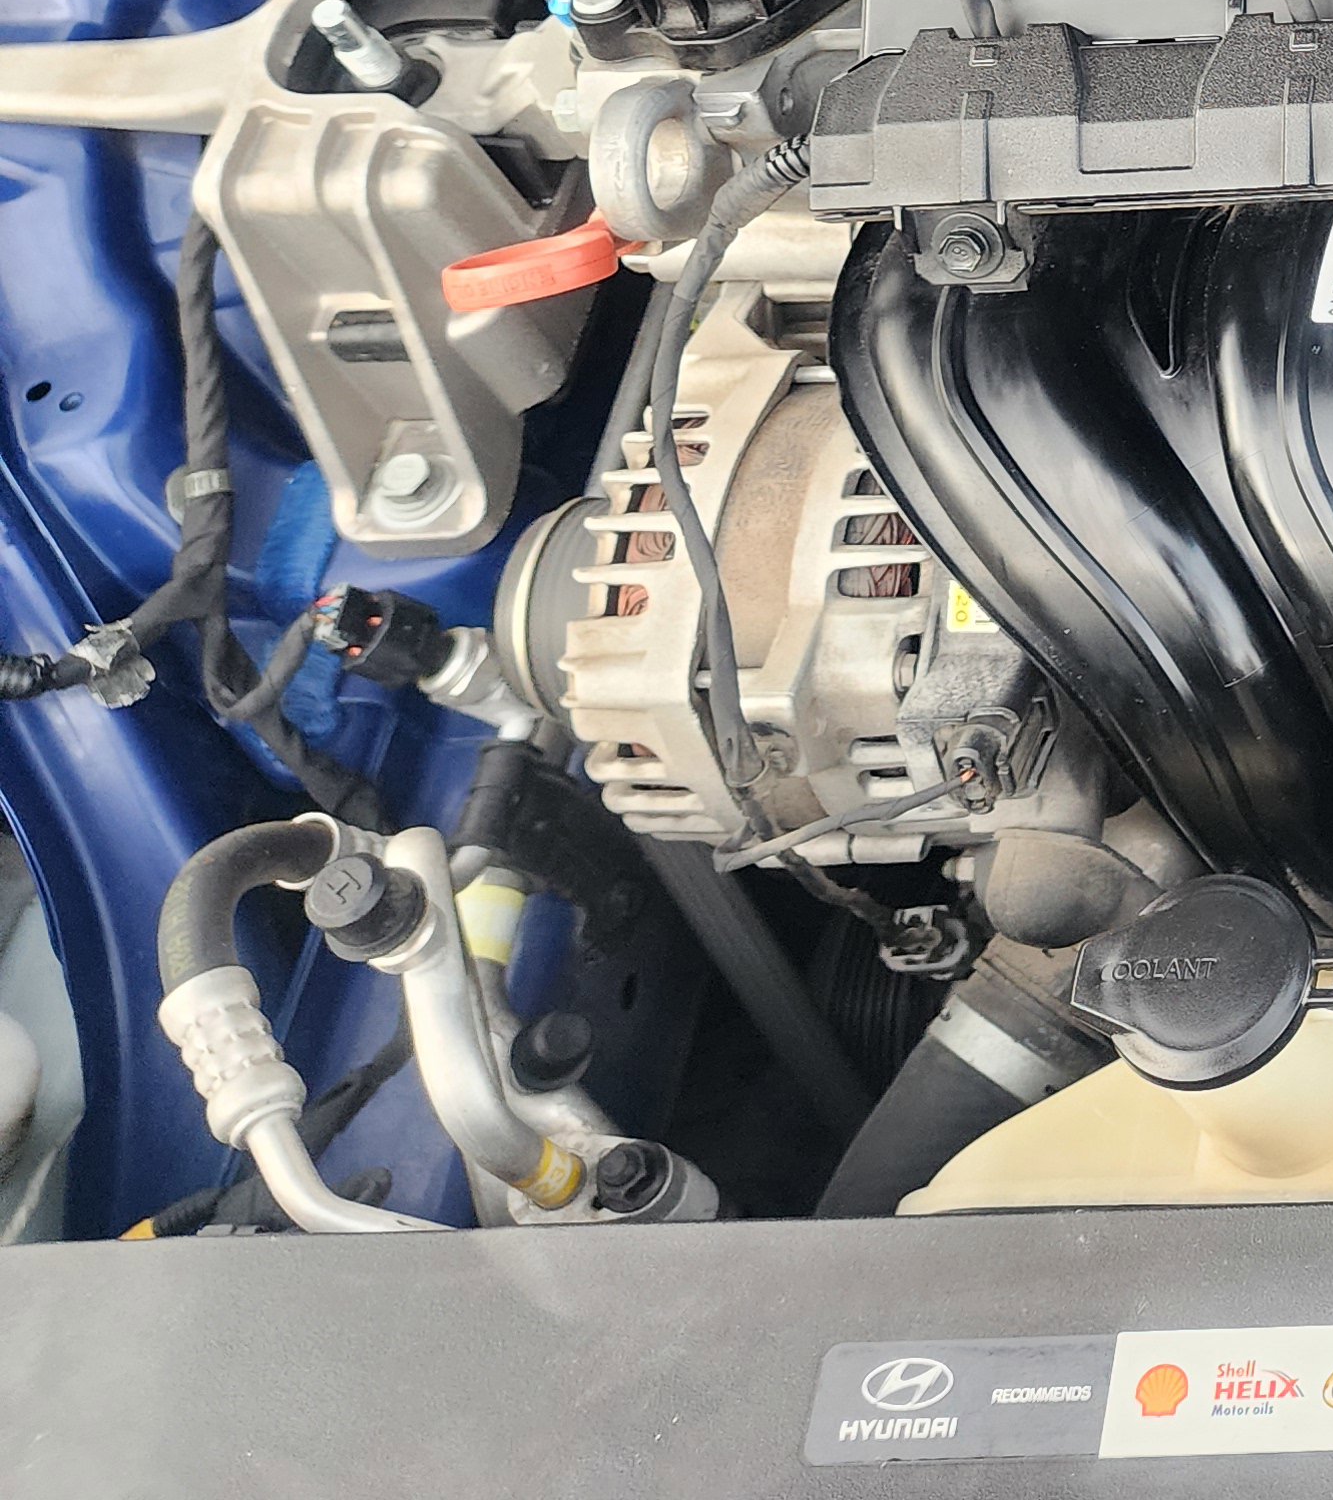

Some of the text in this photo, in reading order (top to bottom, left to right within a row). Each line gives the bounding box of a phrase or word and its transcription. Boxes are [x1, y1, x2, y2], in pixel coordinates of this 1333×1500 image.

[1101, 956, 1219, 982] COOLANT
[1216, 1360, 1256, 1379] Shell
[990, 1385, 1092, 1405] RECOMMENDS
[1214, 1377, 1303, 1401] HELIX
[1210, 1401, 1274, 1417] Motor oils
[838, 1416, 959, 1443] HYUNDAI
